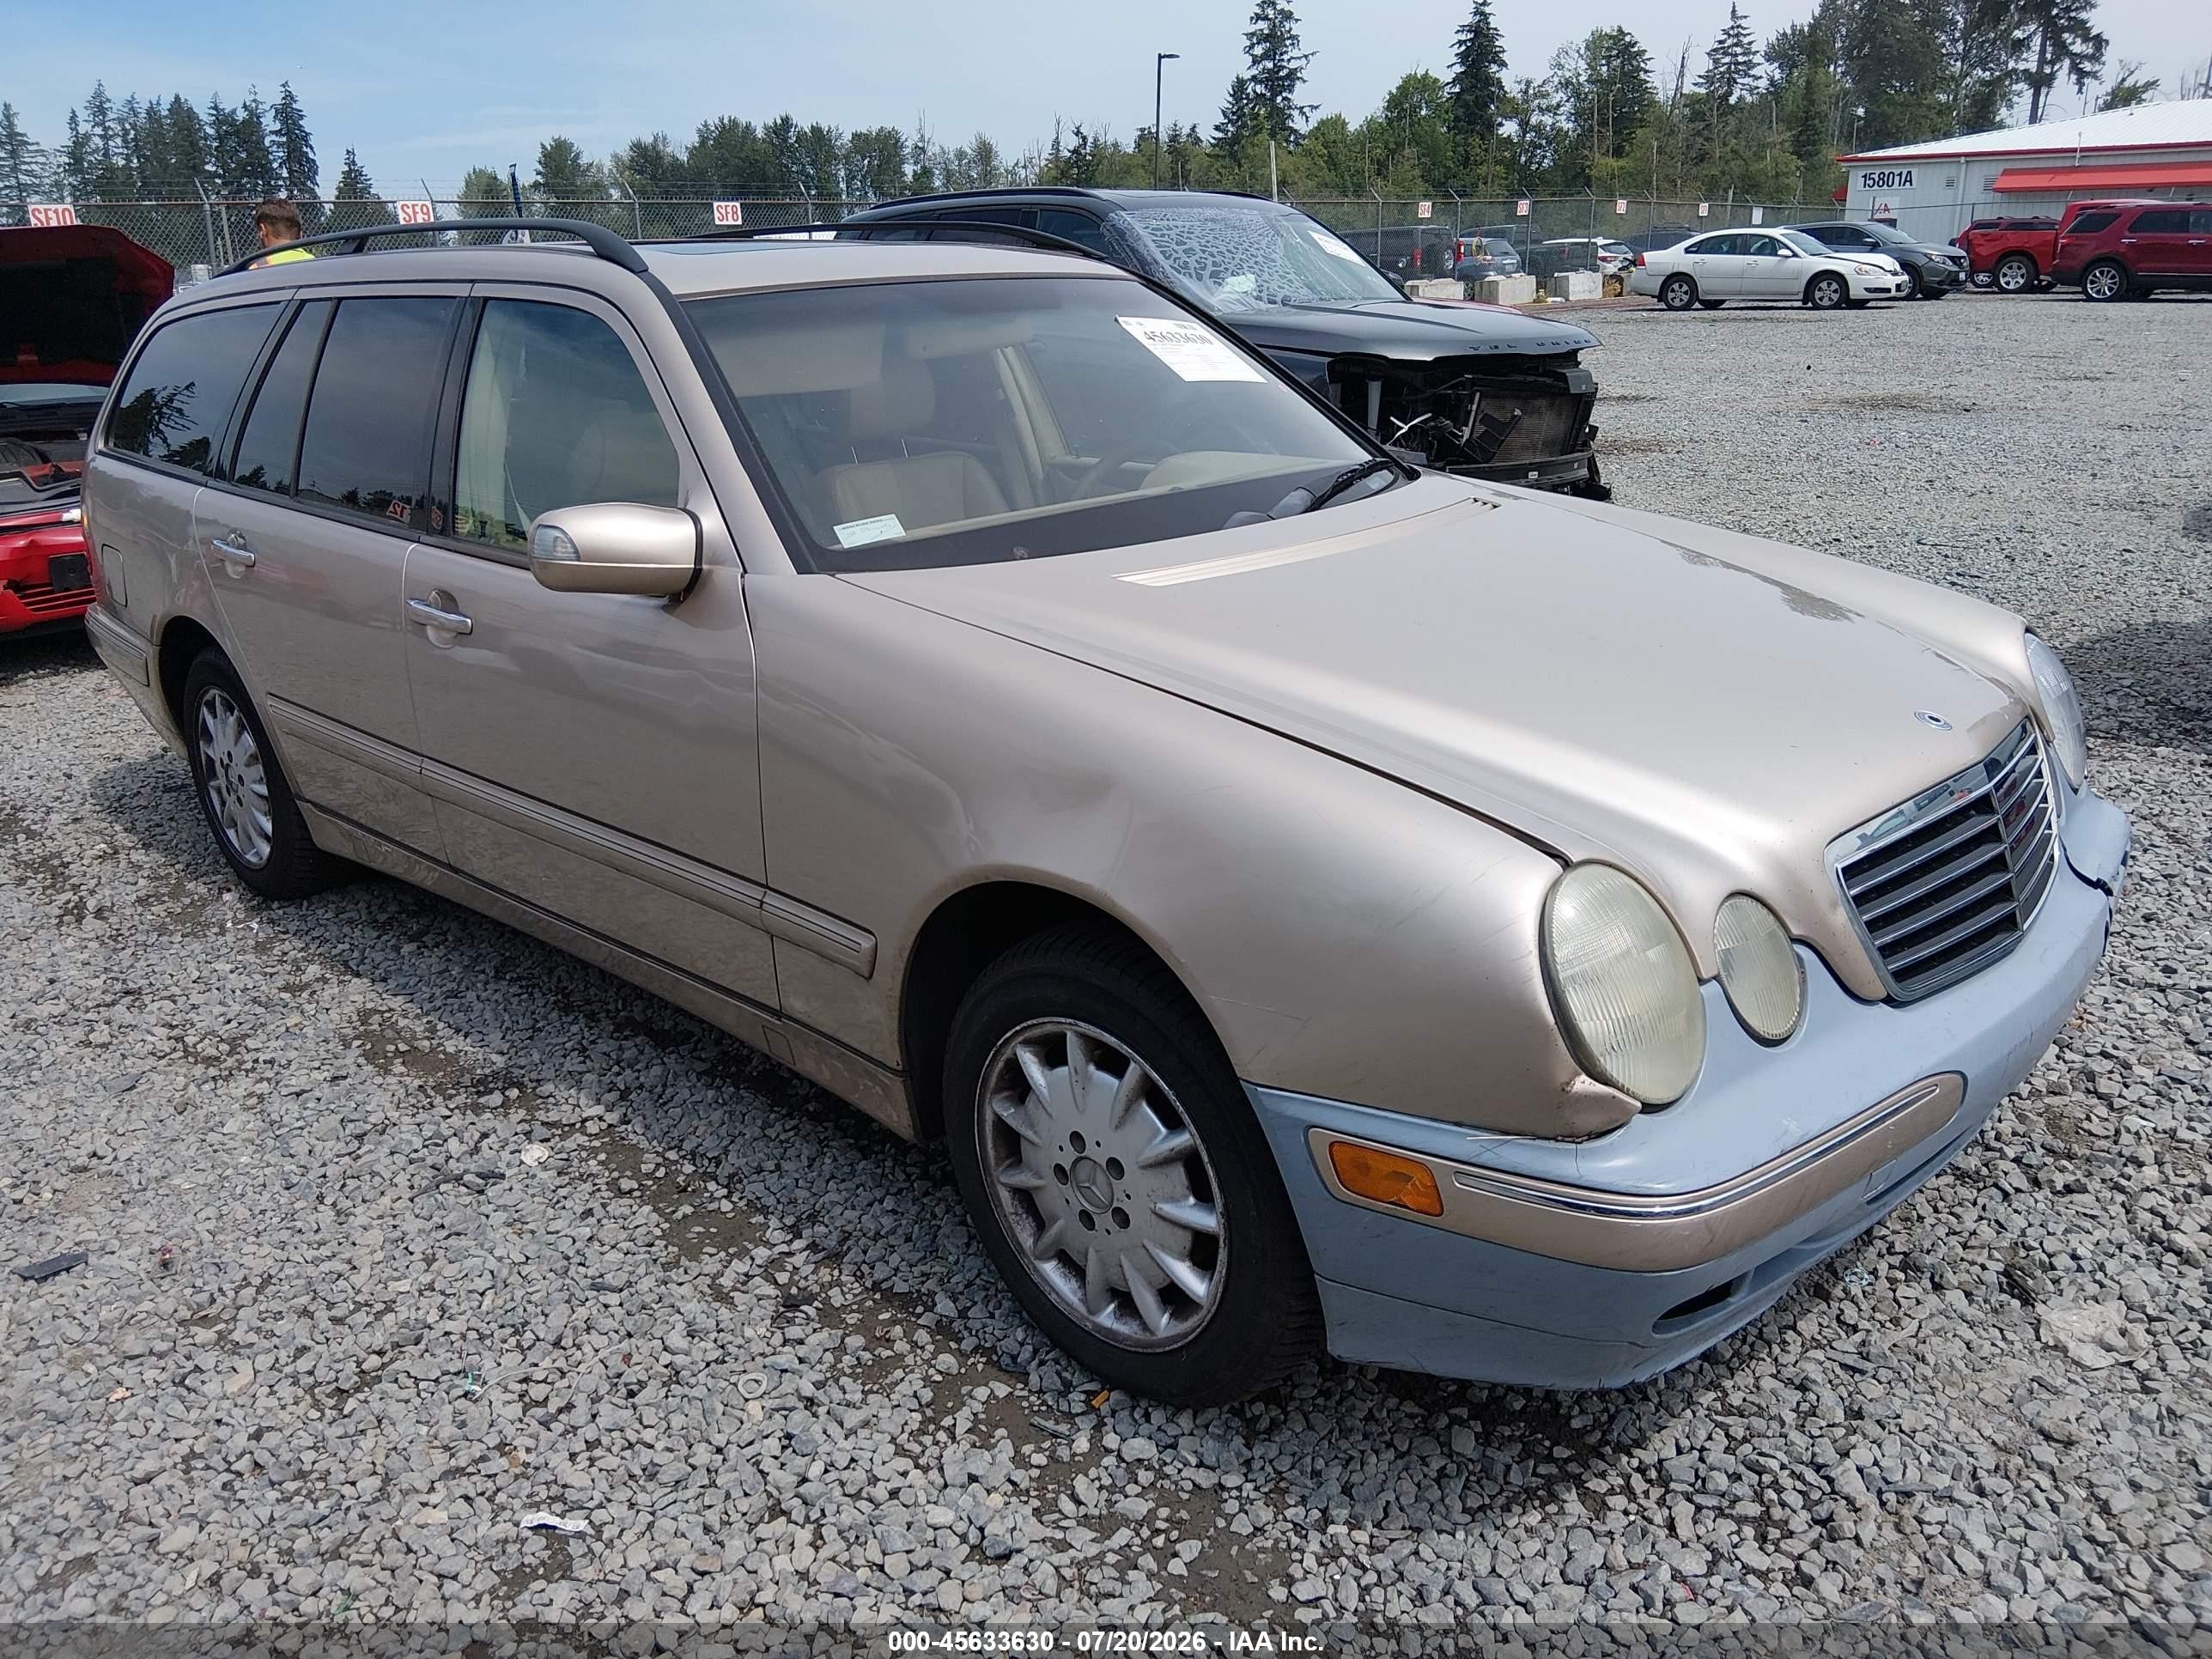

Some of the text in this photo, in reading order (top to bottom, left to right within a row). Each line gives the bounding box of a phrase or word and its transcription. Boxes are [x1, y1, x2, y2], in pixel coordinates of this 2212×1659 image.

[1861, 170, 1913, 189] 15801A
[31, 207, 75, 227] SF10
[400, 203, 431, 223] SF9
[715, 204, 739, 222] SF8
[1143, 331, 1214, 345] 45633630
